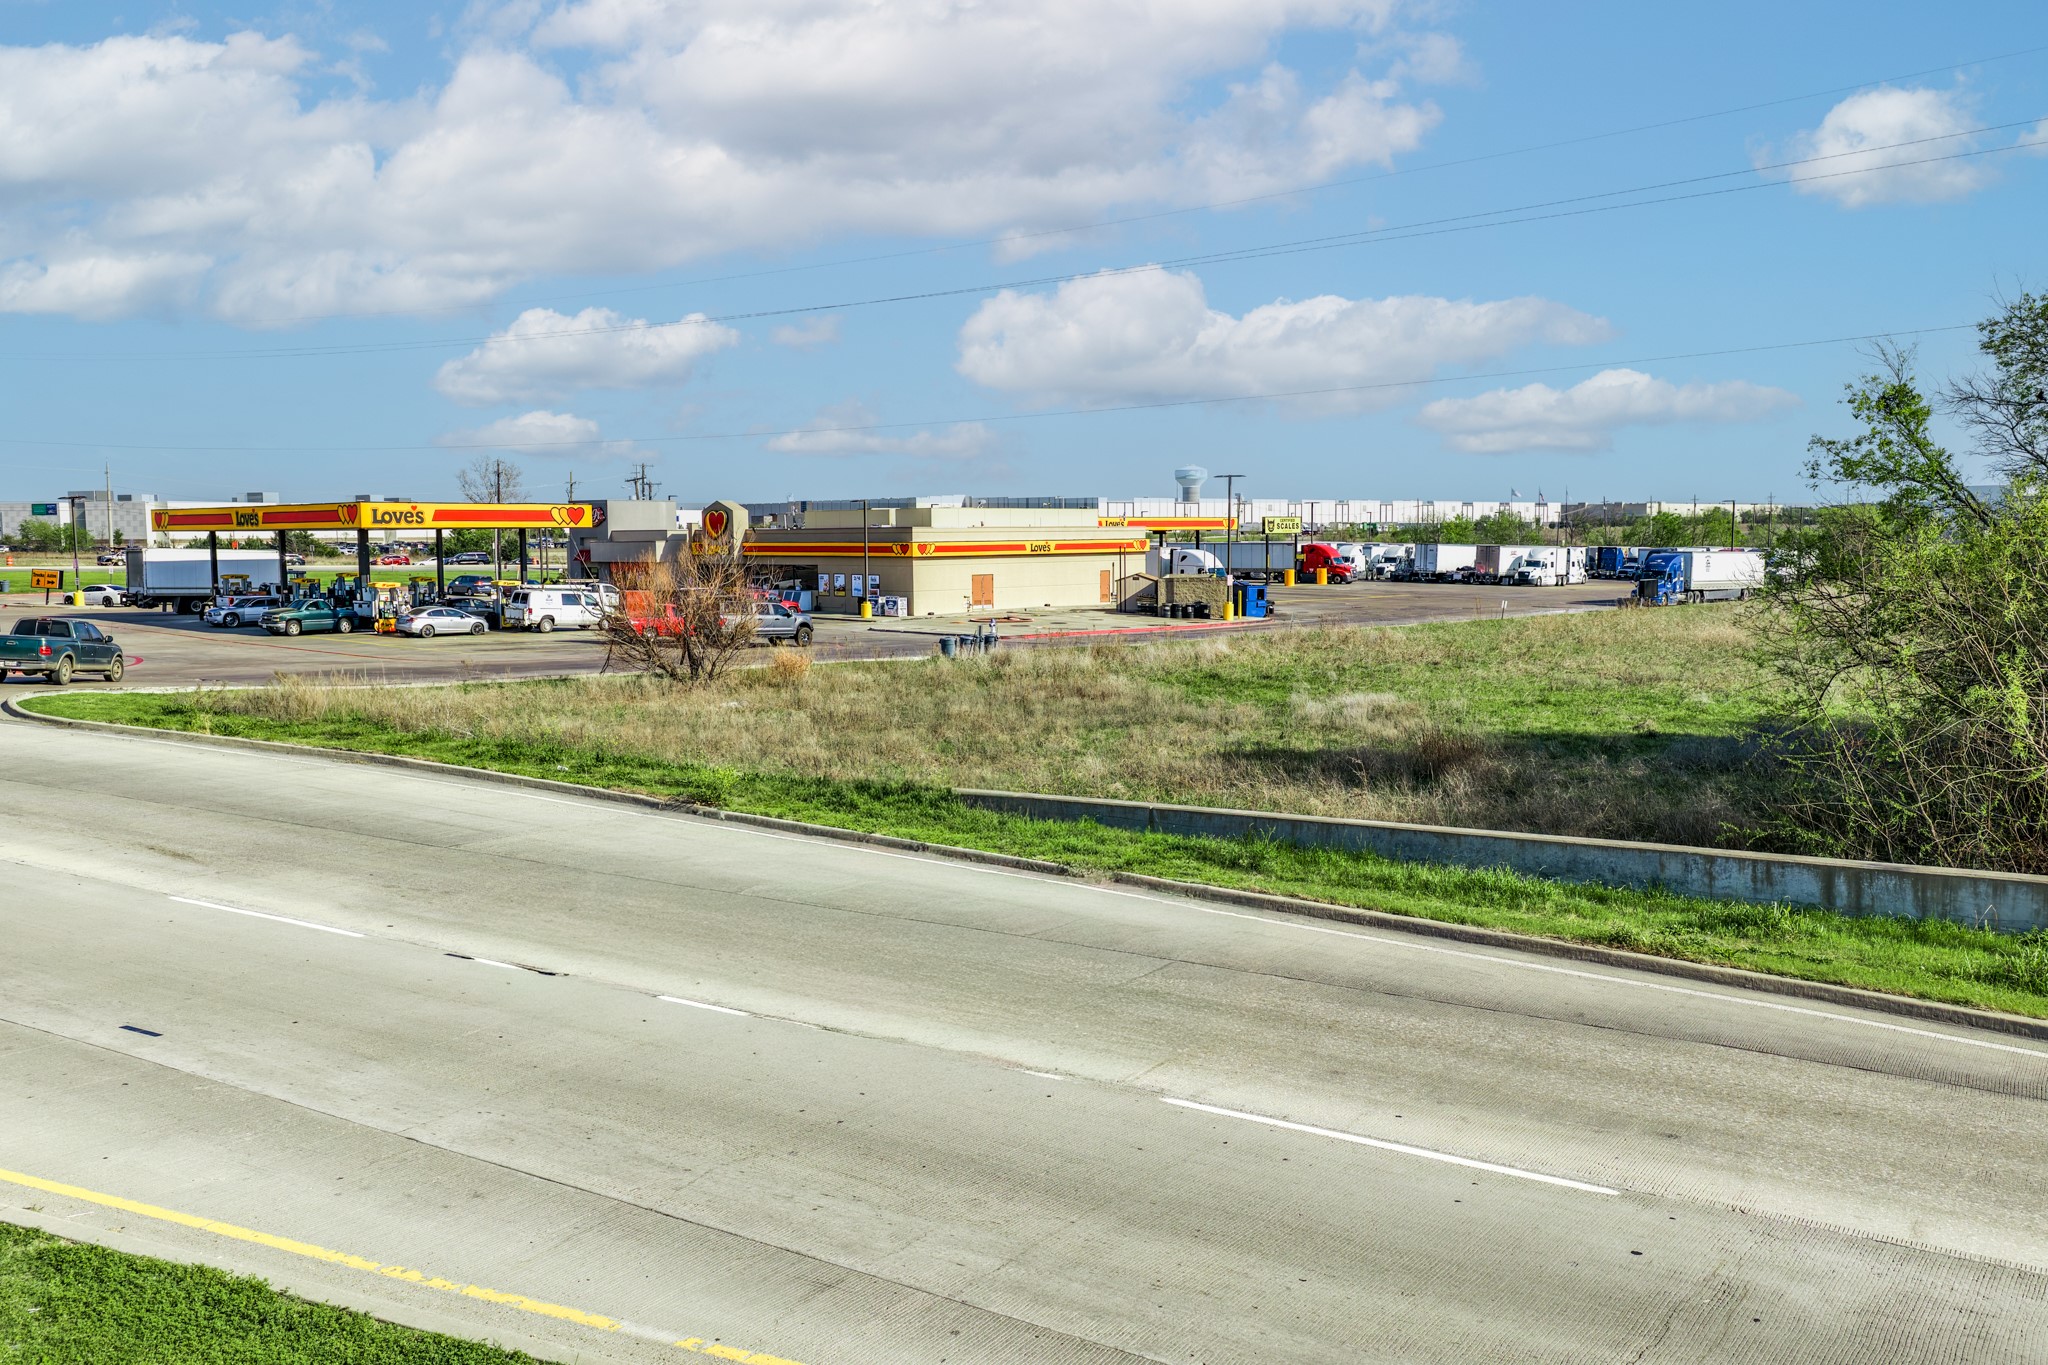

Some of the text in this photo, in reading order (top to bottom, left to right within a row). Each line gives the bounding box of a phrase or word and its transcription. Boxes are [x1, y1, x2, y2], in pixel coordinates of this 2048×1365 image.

[235, 509, 259, 527] Love's
[371, 505, 425, 524] Love's
[1276, 522, 1300, 530] SCALES
[1030, 541, 1051, 552] Love's
